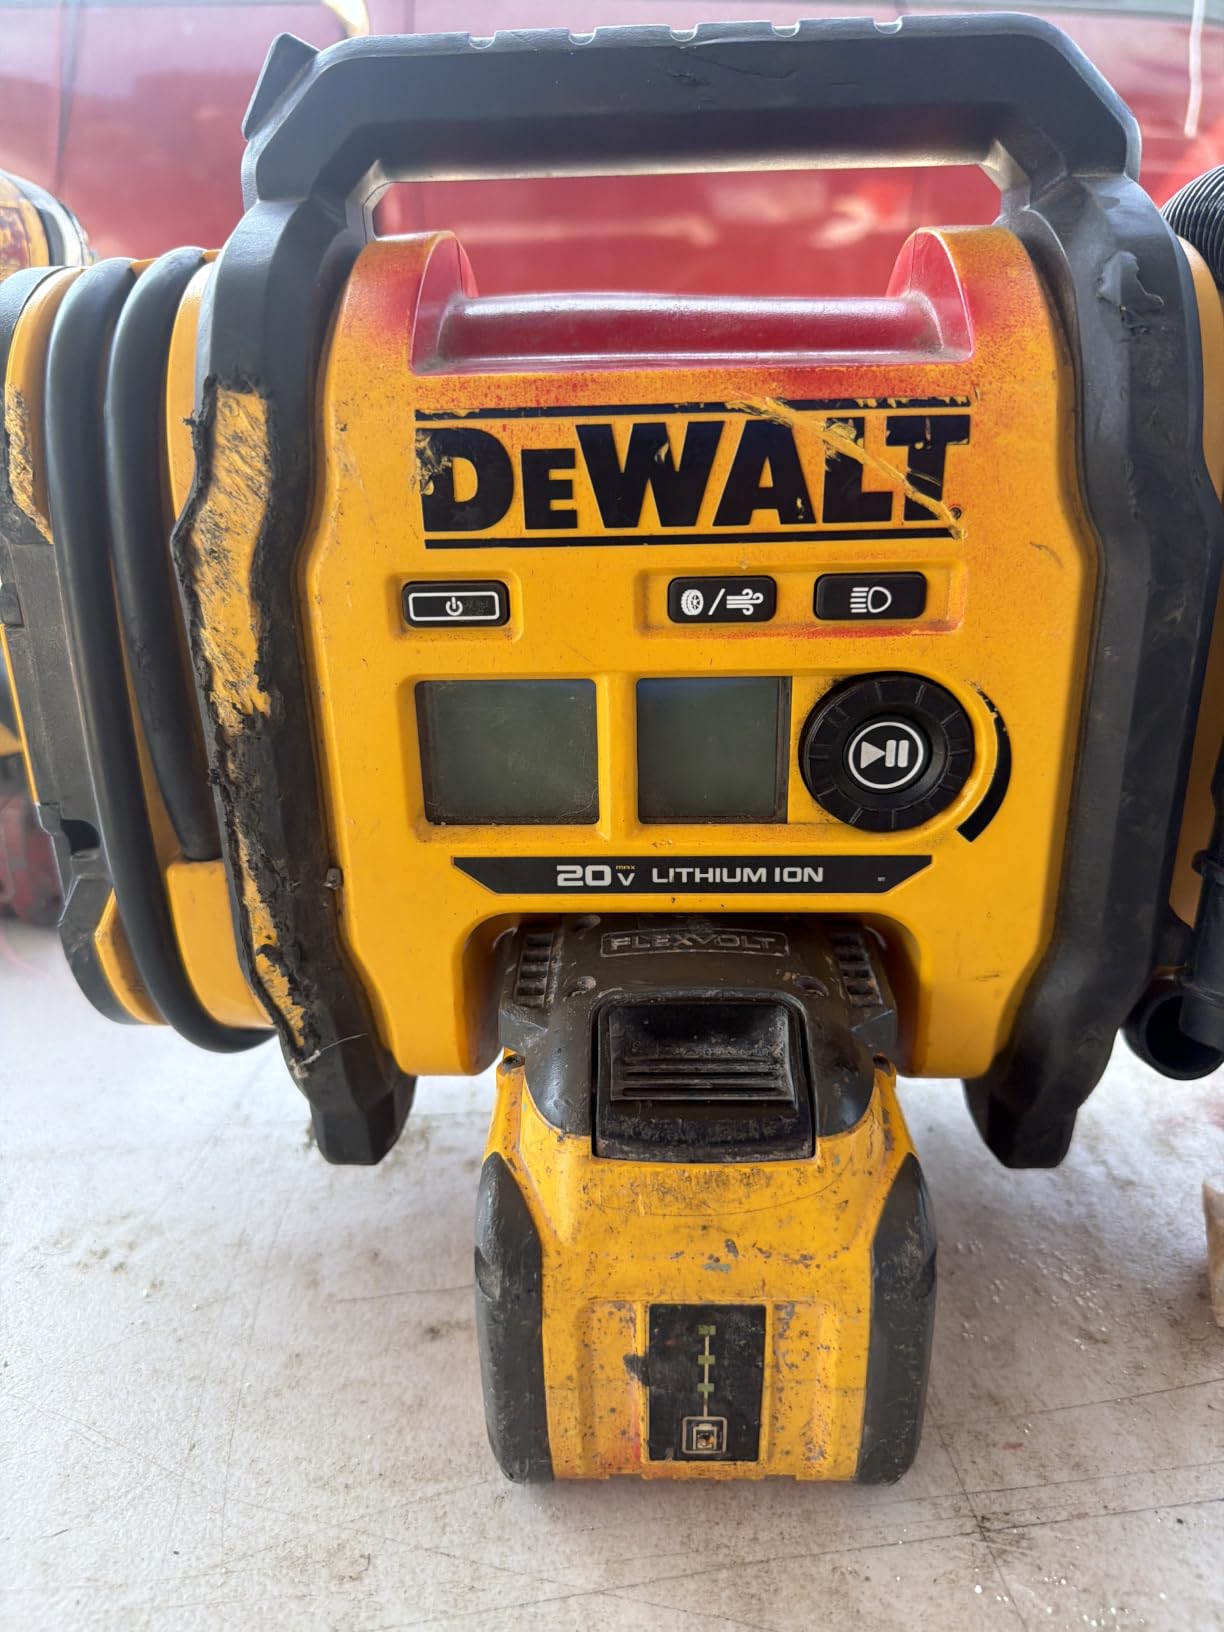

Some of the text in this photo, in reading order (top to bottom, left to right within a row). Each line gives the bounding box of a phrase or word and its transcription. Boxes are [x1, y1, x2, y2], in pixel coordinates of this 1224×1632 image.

[415, 414, 970, 532] DEWALT
[652, 867, 767, 883] LITHIUM
[774, 867, 824, 883] ION
[610, 933, 776, 950] FLEXVOLT
